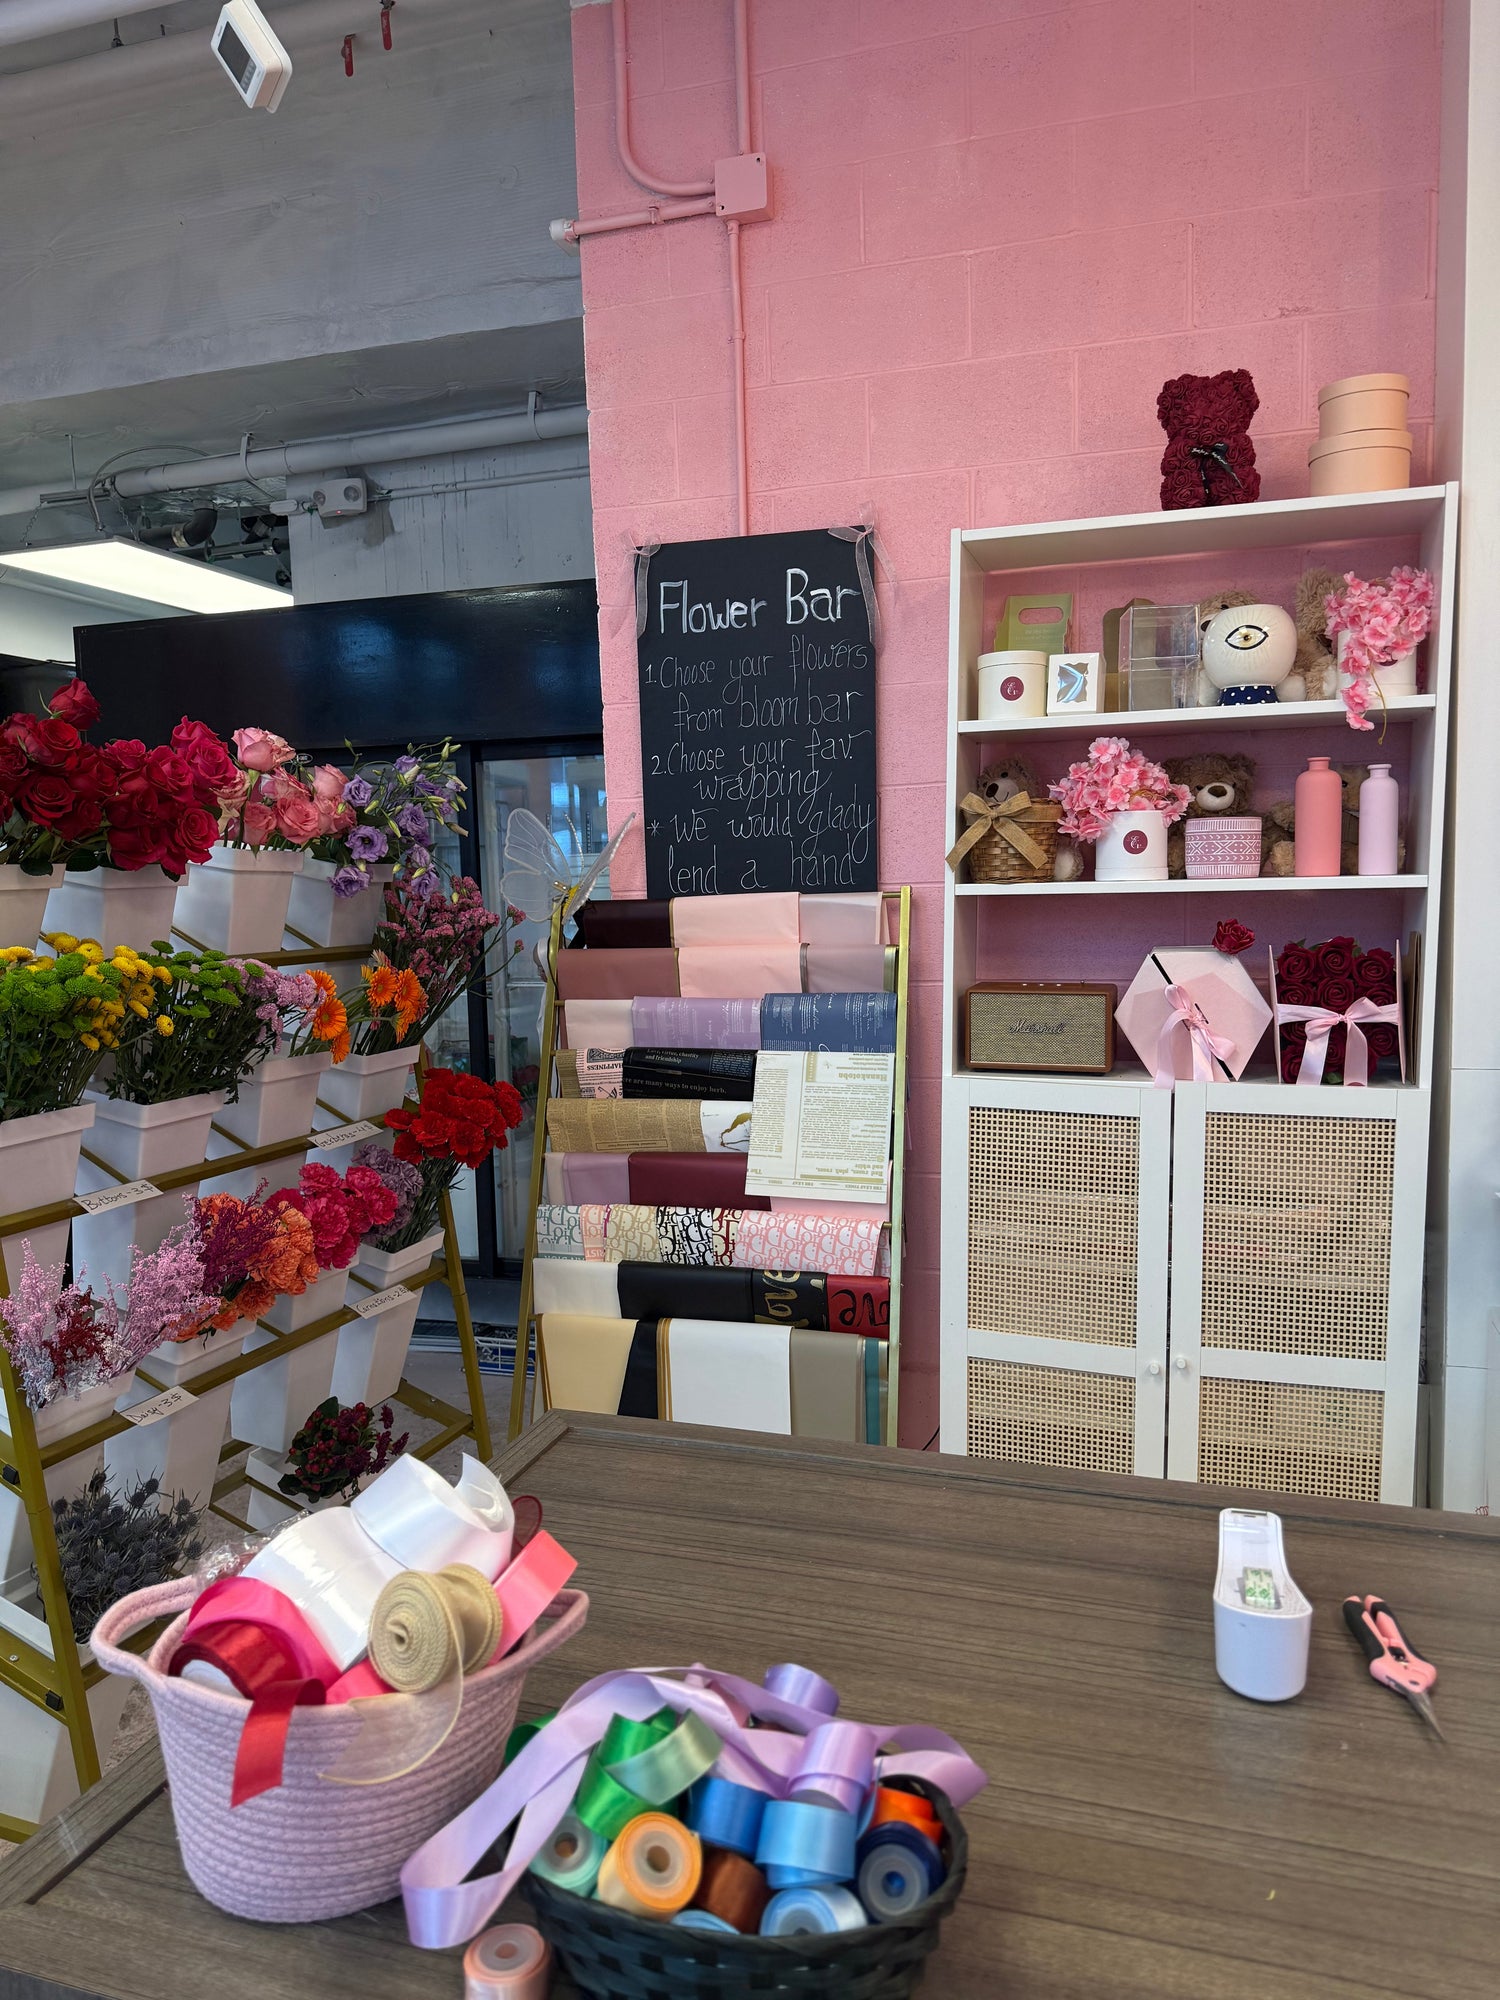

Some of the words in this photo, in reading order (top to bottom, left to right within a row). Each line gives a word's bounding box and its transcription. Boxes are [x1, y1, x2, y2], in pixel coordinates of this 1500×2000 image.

[659, 579, 768, 634] Flower
[785, 567, 862, 626] Bar
[722, 656, 774, 704] your
[789, 634, 868, 692] flowers
[673, 692, 723, 742] from
[739, 685, 799, 728] bloom
[806, 677, 864, 726] bar
[722, 738, 796, 786] your
[804, 728, 872, 775] fav.
[670, 807, 720, 843] We
[727, 799, 793, 839] would
[801, 784, 877, 864] glady
[693, 765, 833, 824] wrapping
[668, 844, 720, 894] lend
[740, 859, 768, 890] a
[790, 833, 856, 887] hand
[645, 1079, 662, 1088] many
[664, 1081, 680, 1089] ways
[689, 1084, 707, 1093] enjoy
